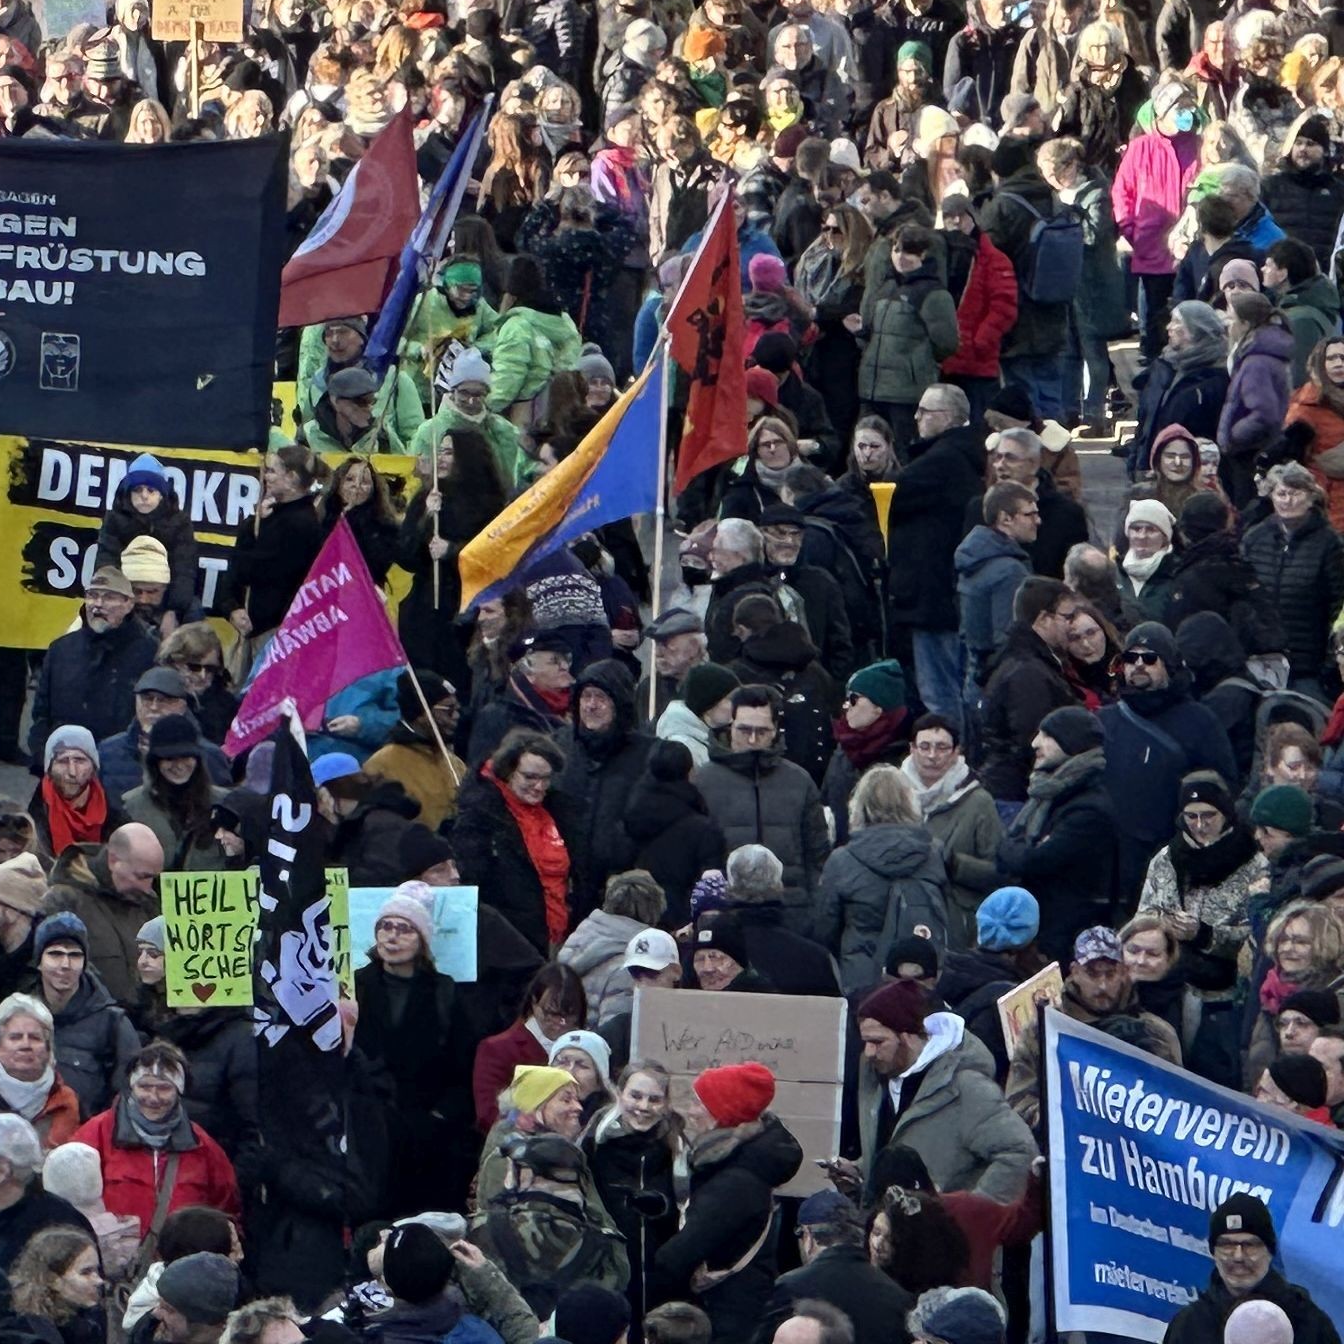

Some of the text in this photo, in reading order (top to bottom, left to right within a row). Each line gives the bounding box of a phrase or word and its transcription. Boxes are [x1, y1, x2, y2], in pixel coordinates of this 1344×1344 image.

[173, 878, 236, 916] HEIL
[1069, 1060, 1292, 1167] Mieterverein
[1078, 1134, 1117, 1182] zu
